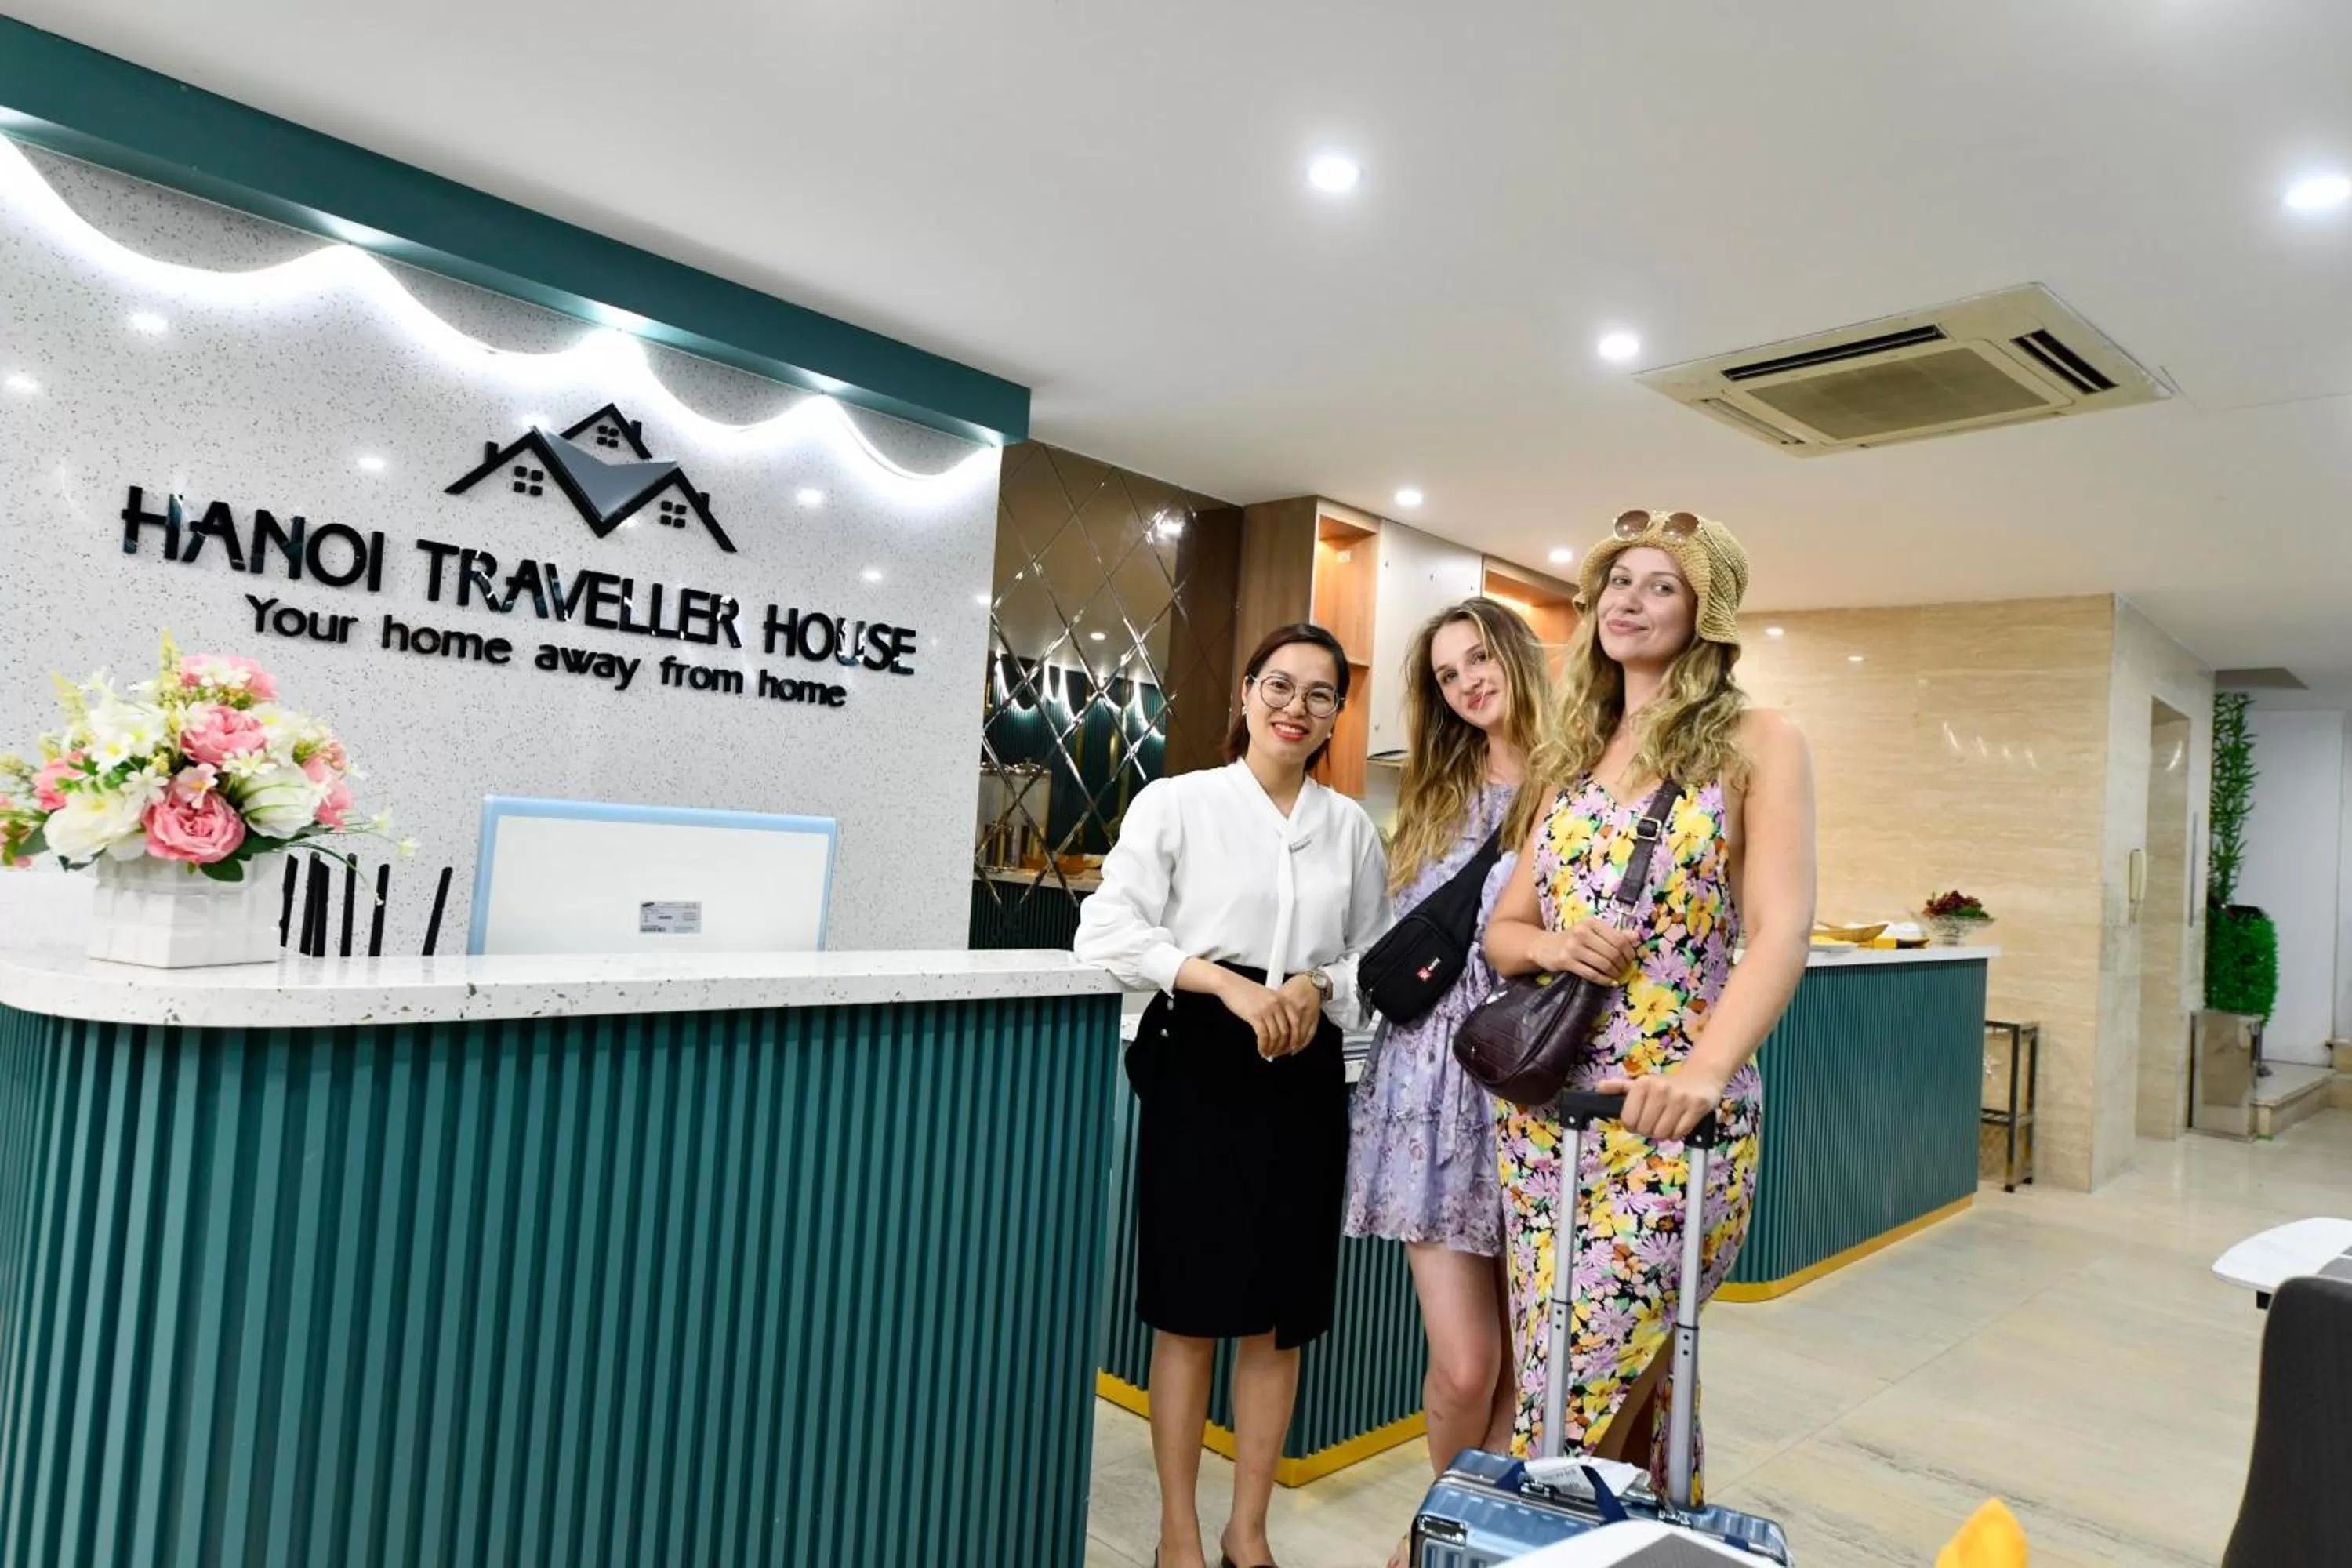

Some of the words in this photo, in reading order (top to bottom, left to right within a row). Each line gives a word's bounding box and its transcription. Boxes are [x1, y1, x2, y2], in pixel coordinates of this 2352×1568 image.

[122, 485, 384, 592] HANOI
[416, 539, 742, 648] TRAVELLER
[764, 603, 916, 674] HOUSE
[245, 593, 358, 644] Your
[382, 614, 513, 664] home
[535, 642, 641, 691] away
[660, 655, 743, 694] from
[758, 669, 847, 706] home
